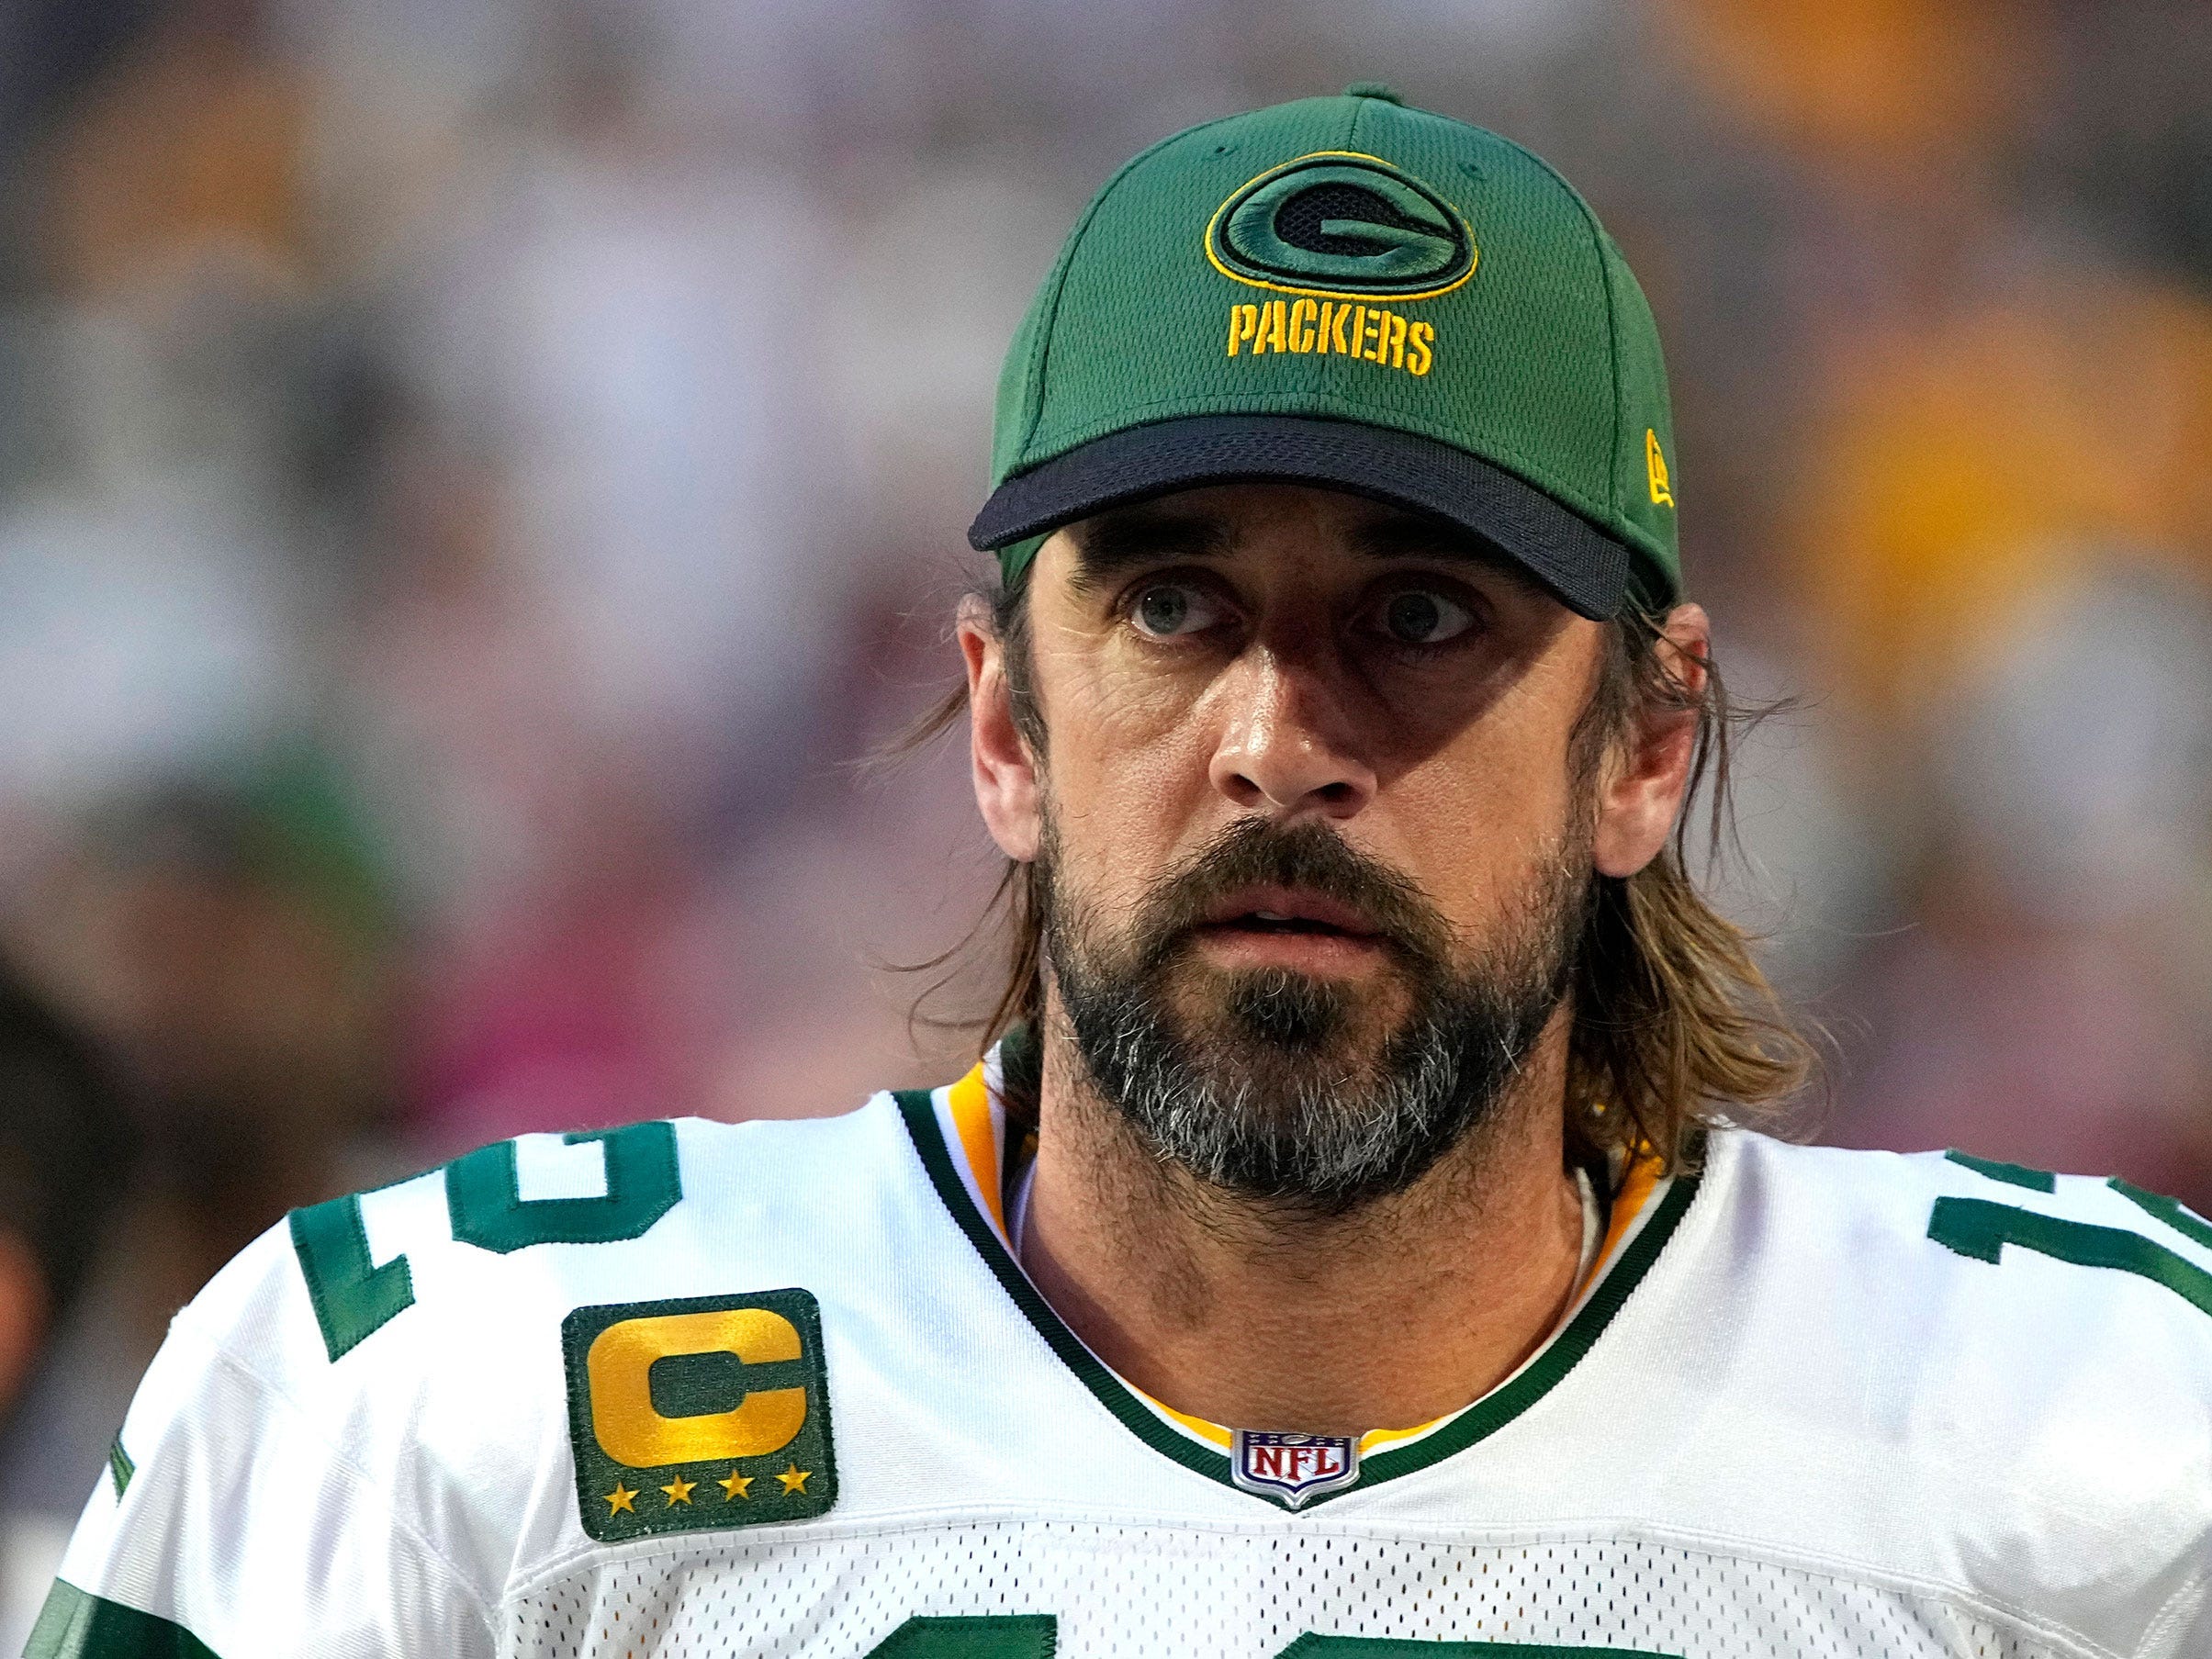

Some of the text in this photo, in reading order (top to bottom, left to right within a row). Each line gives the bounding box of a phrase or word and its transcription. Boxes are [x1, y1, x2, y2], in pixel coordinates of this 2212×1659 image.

[1227, 298, 1435, 376] PACKERS
[587, 1307, 807, 1469] C
[1252, 1446, 1340, 1482] NFL
